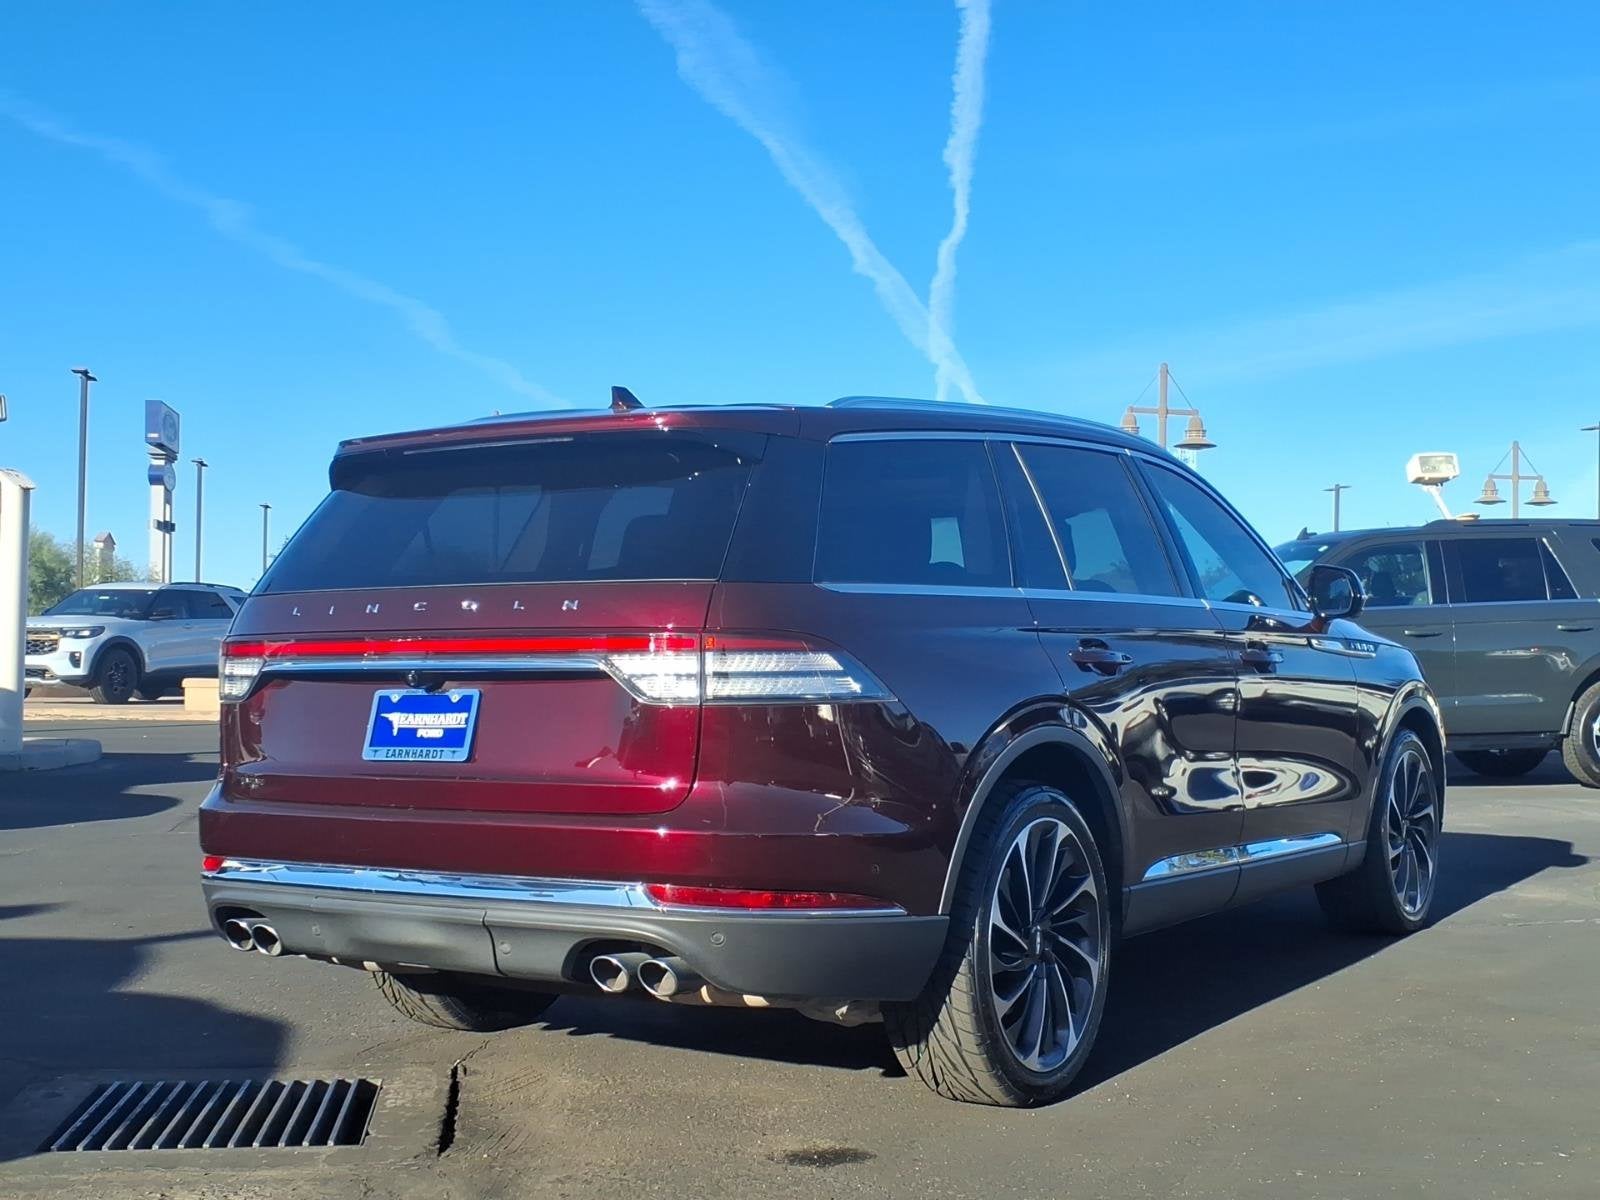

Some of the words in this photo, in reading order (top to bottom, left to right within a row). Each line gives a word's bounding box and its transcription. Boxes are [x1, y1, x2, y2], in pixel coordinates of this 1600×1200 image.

[292, 600, 579, 617] LINCOLN
[398, 712, 469, 725] EARNHARDT
[416, 728, 444, 738] FORD
[385, 749, 445, 759] EARNHARDT
